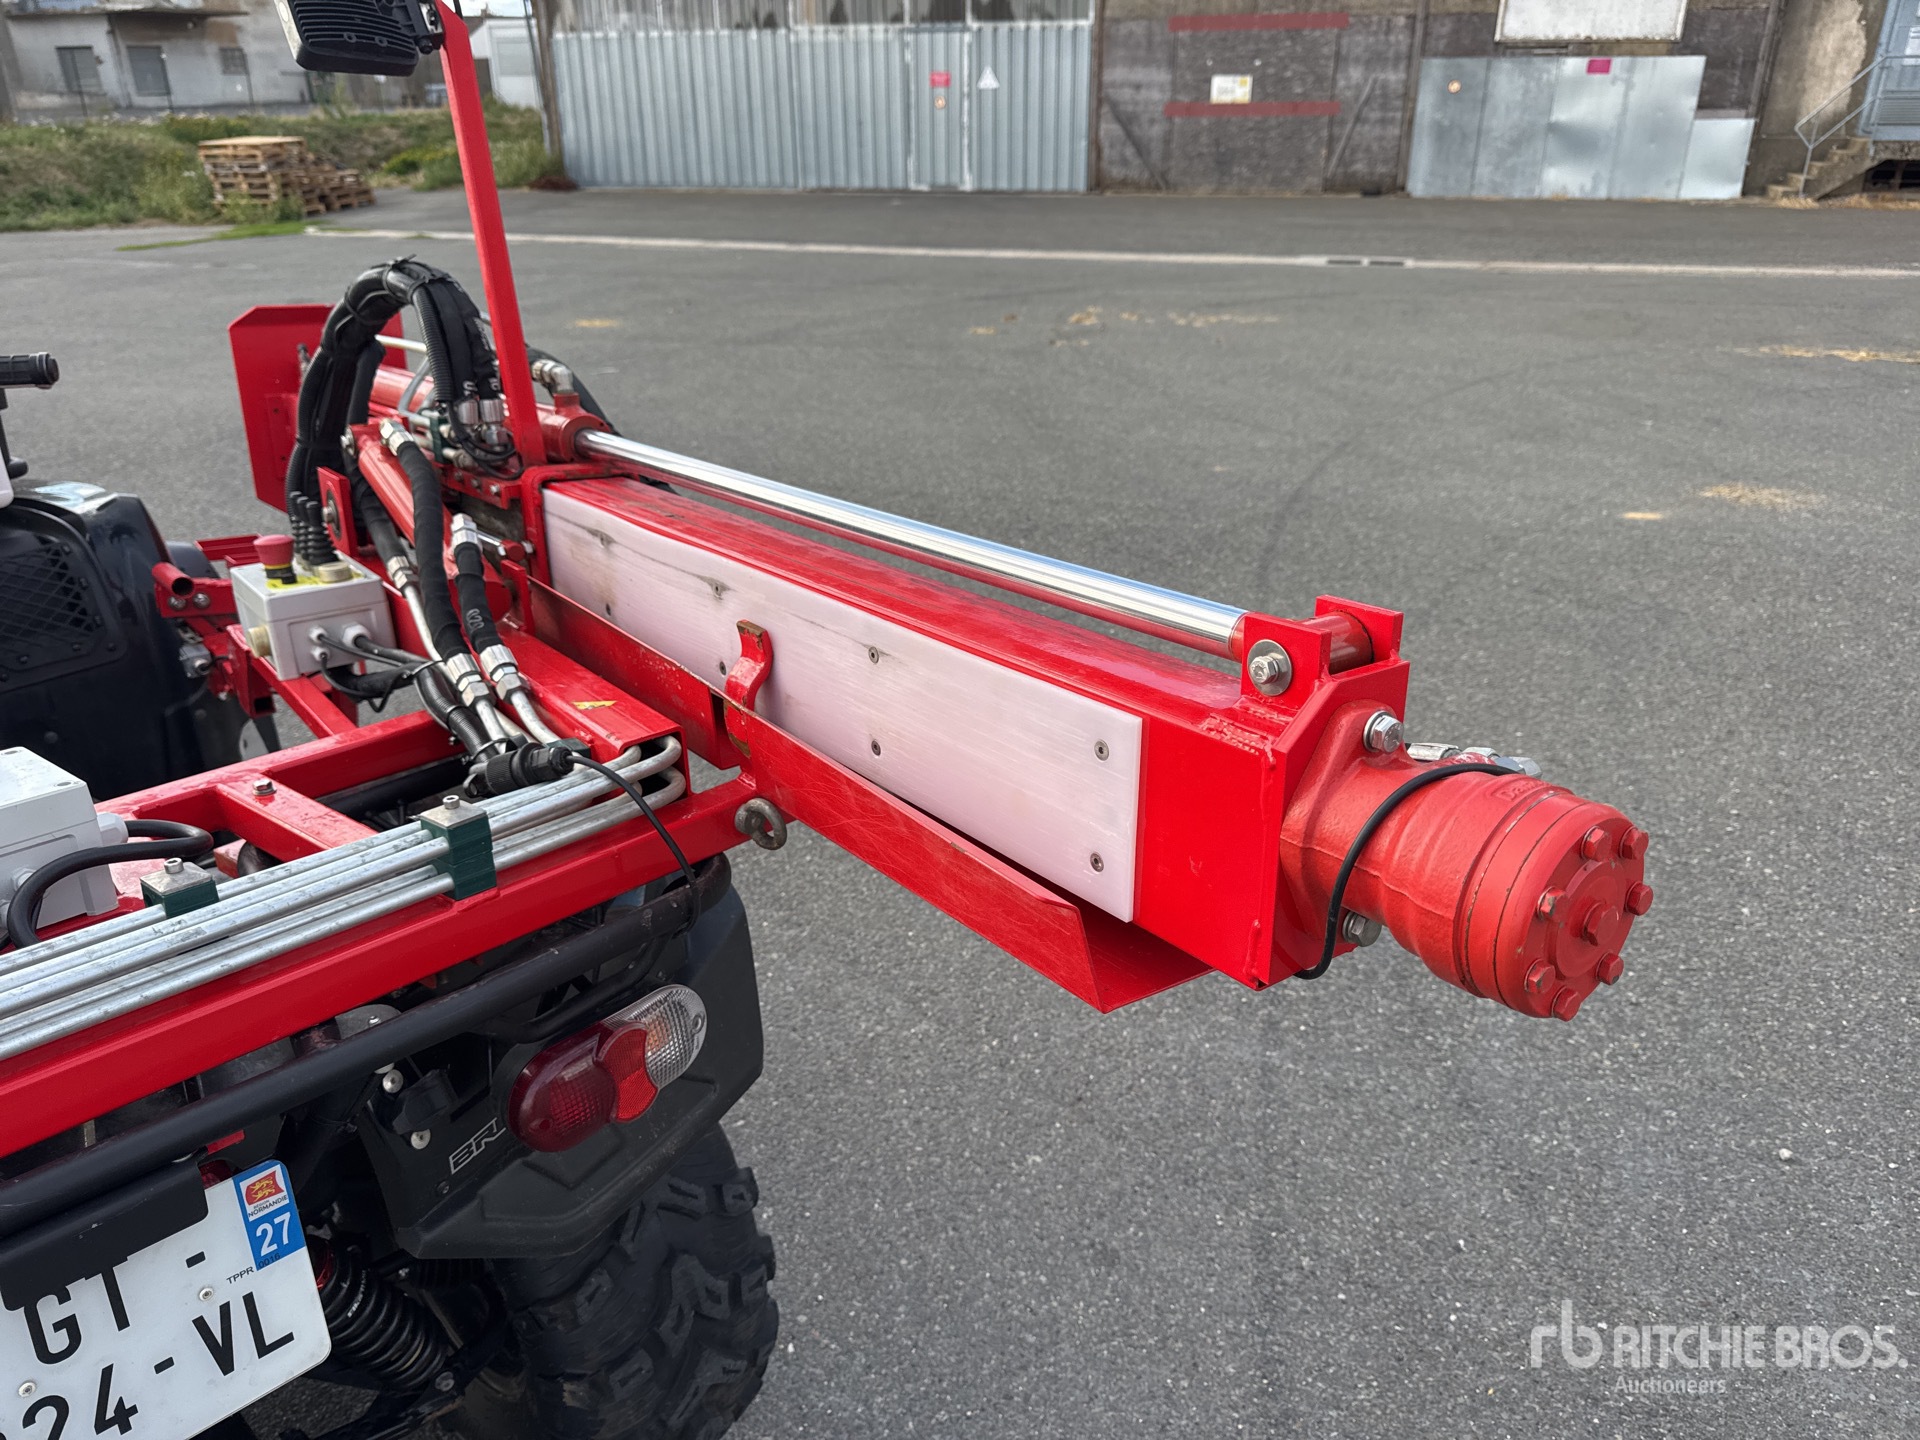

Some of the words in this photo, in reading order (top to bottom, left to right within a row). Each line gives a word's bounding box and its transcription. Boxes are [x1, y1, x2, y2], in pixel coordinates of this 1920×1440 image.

[248, 1194, 288, 1218] NORMANDIE
[256, 1211, 291, 1257] 27
[226, 1266, 254, 1284] TPPR
